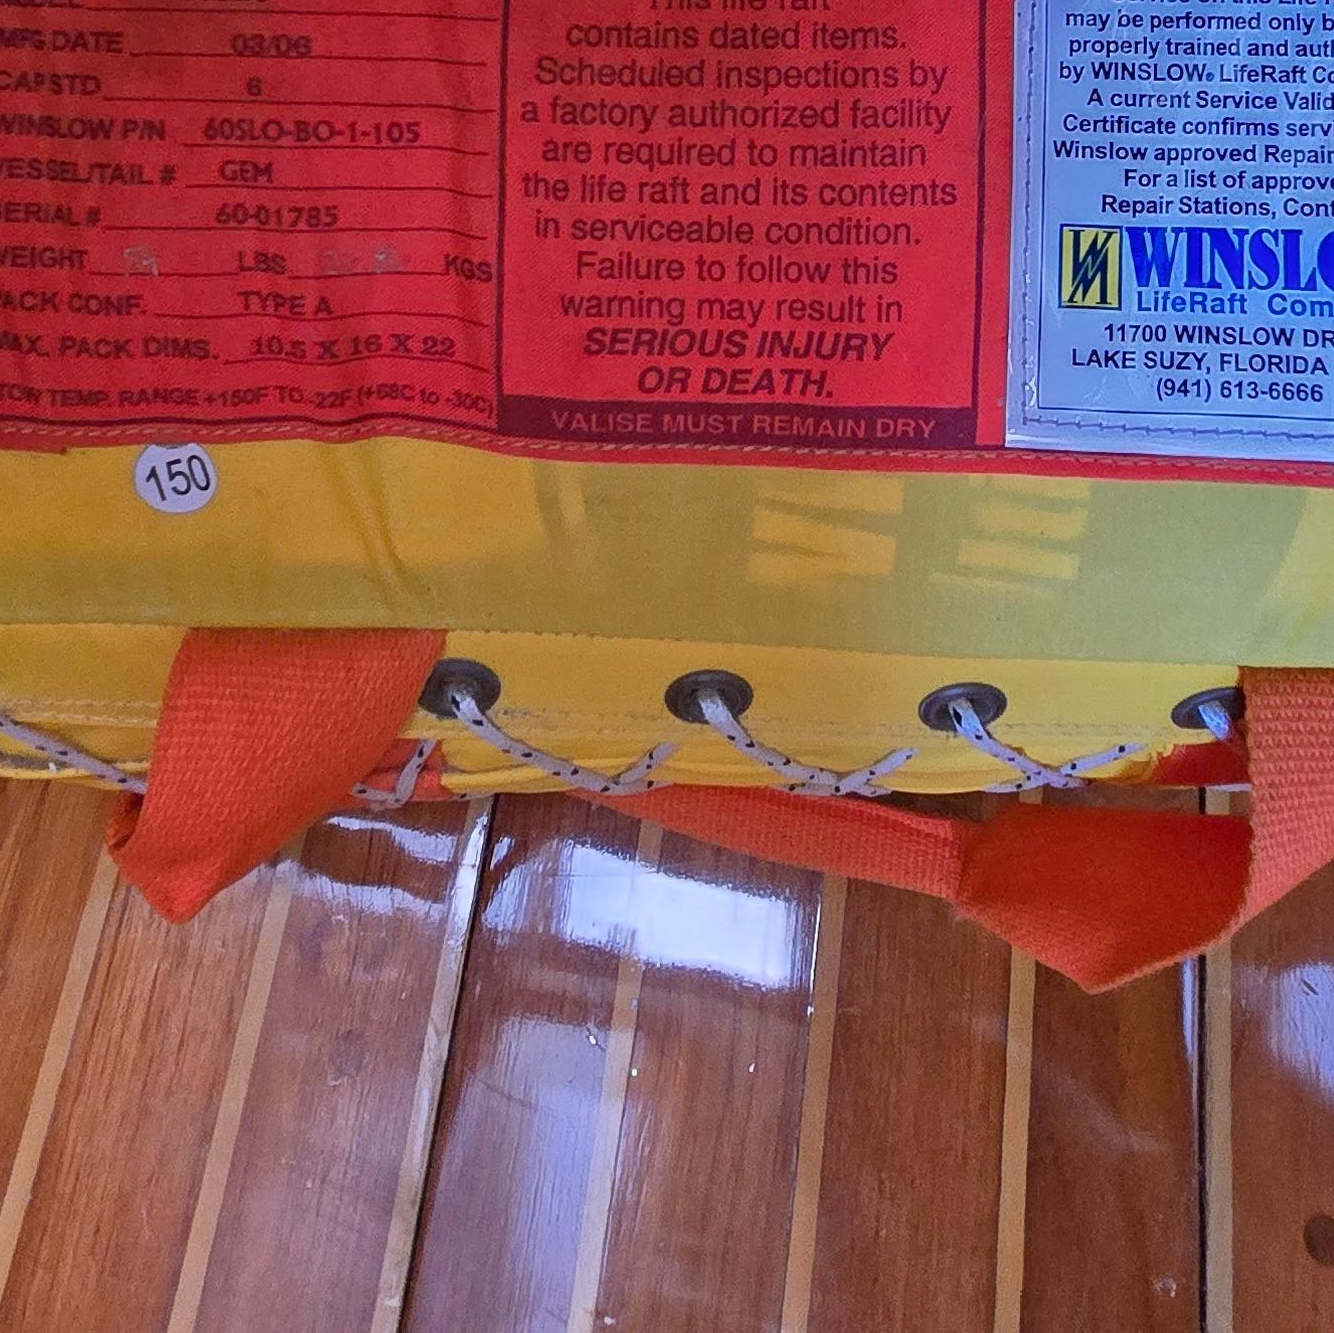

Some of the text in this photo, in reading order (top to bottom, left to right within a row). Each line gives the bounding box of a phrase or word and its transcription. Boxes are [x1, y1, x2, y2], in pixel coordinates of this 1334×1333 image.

[1066, 14, 1110, 31] may
[1118, 10, 1143, 28] be
[1150, 11, 1261, 33] performed
[1269, 14, 1314, 35] only
[52, 30, 124, 53] DATE
[567, 22, 907, 50] contains dated items.
[1069, 38, 1159, 58] properly
[1166, 37, 1240, 57] trained
[1247, 38, 1289, 58] and
[536, 57, 948, 95] Scheduled inspections by
[1059, 61, 1084, 82] by
[1220, 65, 1306, 84] LifeRaft
[247, 75, 262, 96] 6
[1087, 89, 1104, 107] A
[1110, 92, 1190, 108] current
[1196, 92, 1277, 110] Service
[520, 98, 952, 134] a factory authorized facility
[1063, 114, 1175, 135] Certificate
[1182, 116, 1279, 136] confirms
[121, 119, 165, 140] P/N
[542, 138, 926, 172] are required to maintain
[1053, 141, 1148, 160] Winslow
[1153, 143, 1257, 166] approved
[220, 160, 273, 183] GEM
[1123, 170, 1162, 187] For
[1167, 175, 1178, 189] a
[1184, 170, 1216, 189] list
[1222, 171, 1245, 189] of
[523, 173, 957, 207] the life raft and its contents
[217, 203, 338, 228] 60-01785
[1101, 195, 1170, 217] Repair
[1178, 197, 1277, 219] Stations,
[535, 211, 920, 246] in serviceable condition.
[238, 251, 286, 274] LBS
[443, 254, 492, 283] KGS
[575, 250, 898, 285] Failure to follow this
[69, 293, 148, 315] CONF.
[238, 291, 305, 315] TYPE
[315, 296, 333, 315] A
[560, 292, 903, 328] warning may result in
[1138, 291, 1247, 315] LifeRaft
[59, 336, 134, 358] PACK
[142, 336, 219, 360] DIMS.
[253, 335, 307, 358] 10.5
[317, 339, 340, 358] X
[349, 334, 382, 355] 16
[390, 334, 415, 354] X
[421, 336, 456, 357] 22
[583, 328, 894, 361] SERIOUS INJURY
[1104, 324, 1167, 343] 11700
[1174, 325, 1294, 347] WINSLOW
[1072, 349, 1136, 369] LAKE
[1143, 352, 1211, 374] SUZY,
[1220, 353, 1329, 375] FLORIDA
[638, 367, 834, 398] OR DEATH.
[1156, 379, 1323, 402] (941) 613-6666
[118, 388, 199, 406] RANGE
[552, 411, 936, 439] VALISE MUST REMAIN DRY
[145, 455, 211, 502] 150
